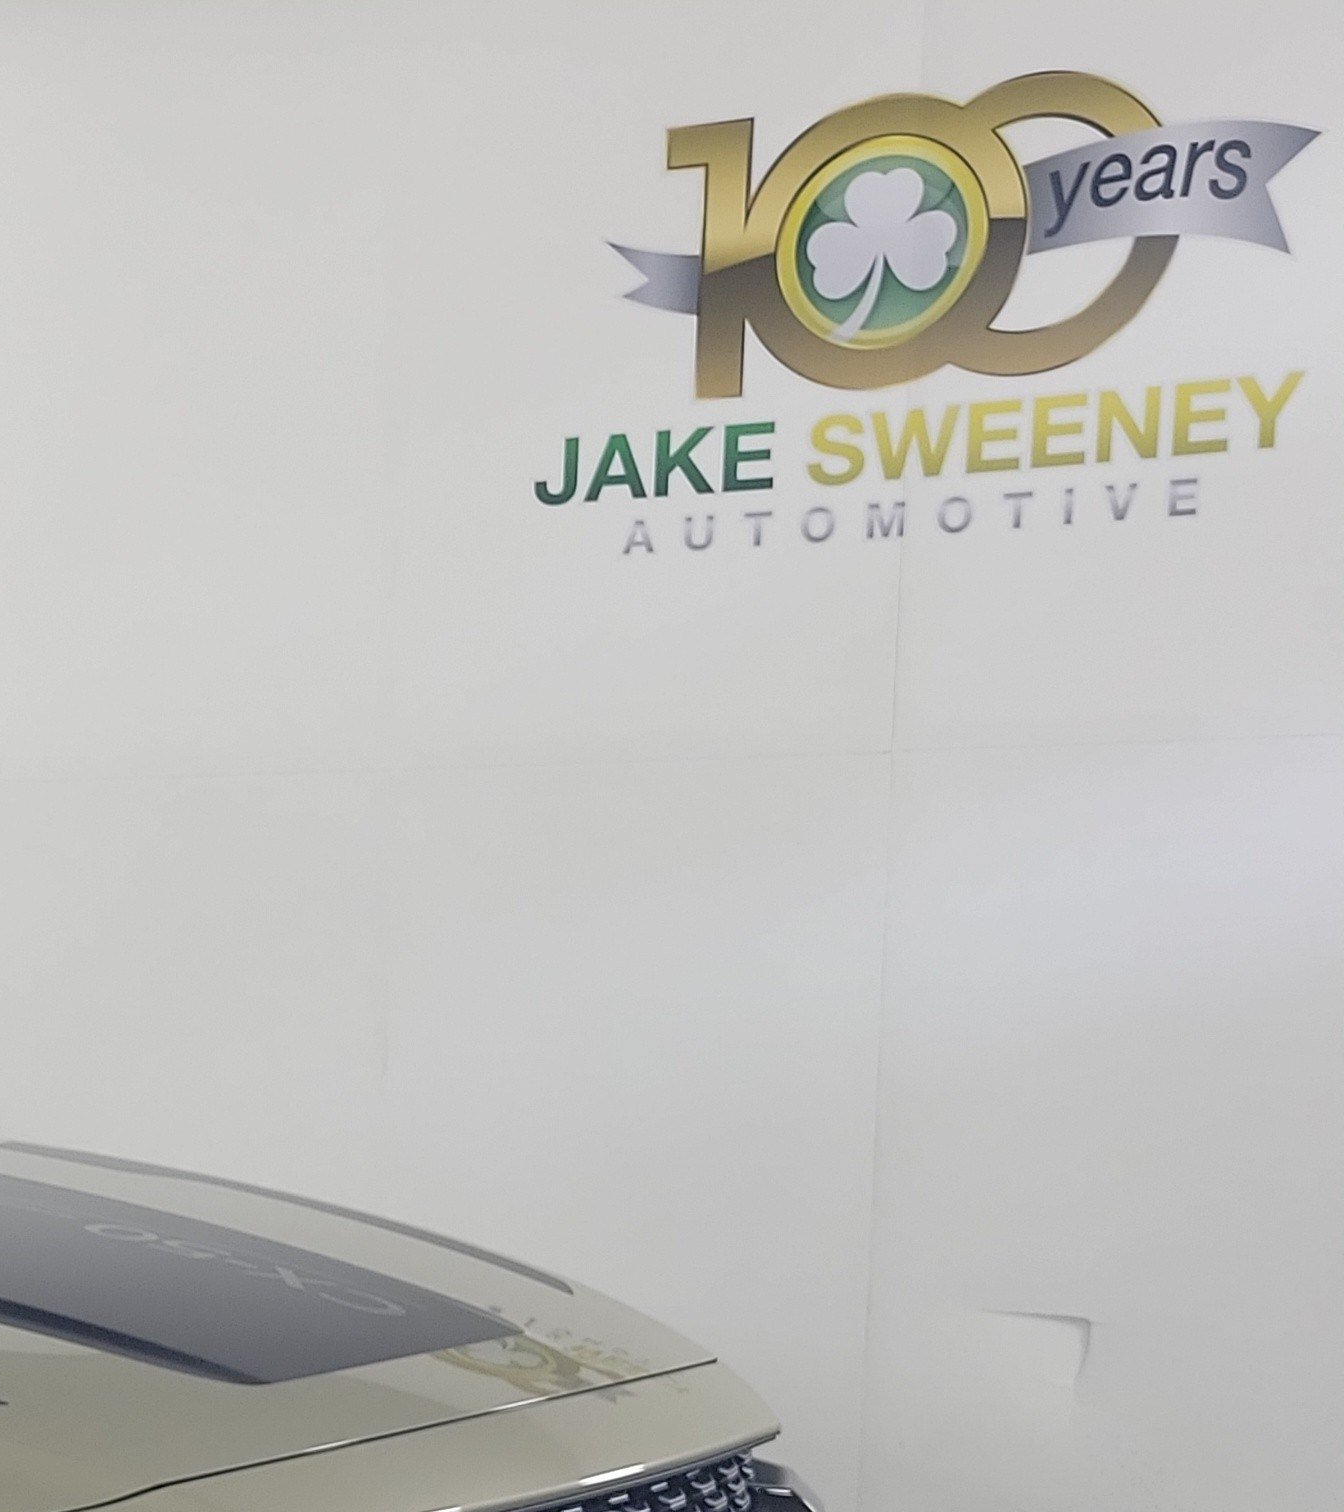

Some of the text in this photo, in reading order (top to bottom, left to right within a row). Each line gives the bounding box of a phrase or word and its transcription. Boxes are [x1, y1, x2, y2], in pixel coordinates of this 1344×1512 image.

[1045, 137, 1253, 238] years
[533, 370, 1307, 506] JAKE SWEENEY
[621, 478, 1201, 556] AUTOMOTIVE
[84, 1222, 406, 1317] CX-50
